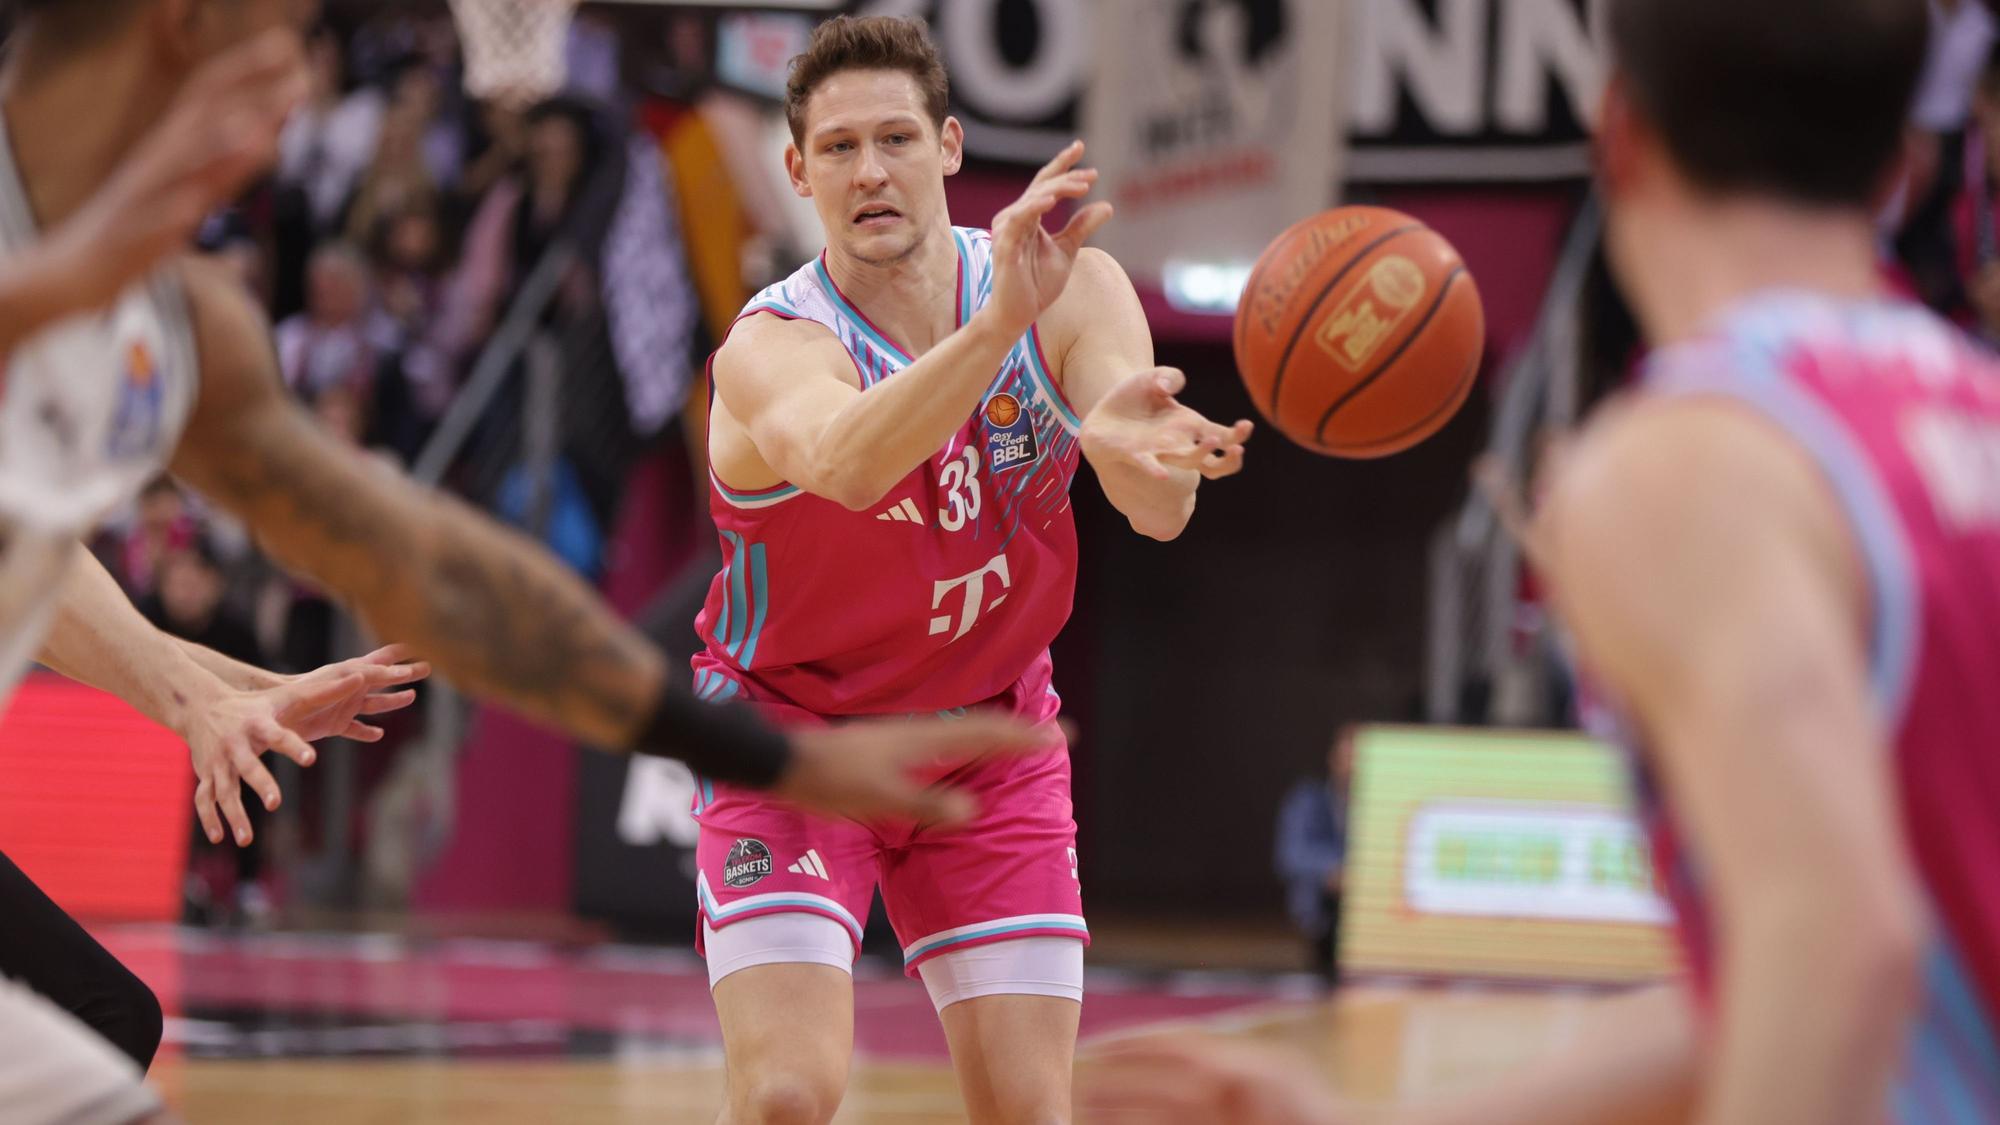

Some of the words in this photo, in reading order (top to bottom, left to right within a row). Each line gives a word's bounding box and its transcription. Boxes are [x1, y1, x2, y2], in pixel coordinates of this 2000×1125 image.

[1000, 434, 1029, 447] Credit
[993, 443, 1031, 467] BBL
[938, 445, 981, 532] 33
[726, 858, 769, 882] BASKETS
